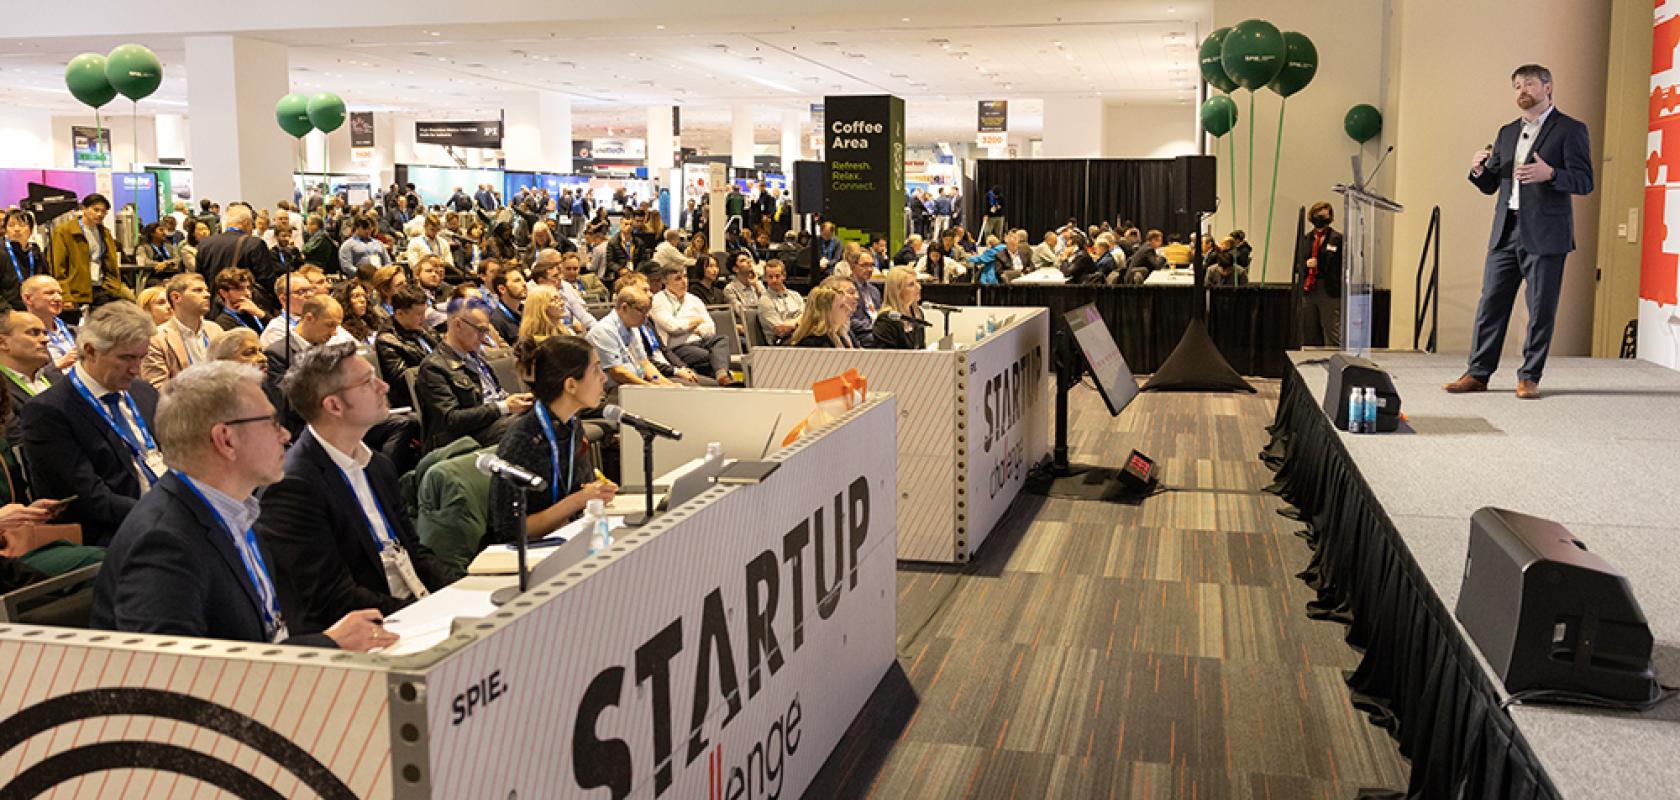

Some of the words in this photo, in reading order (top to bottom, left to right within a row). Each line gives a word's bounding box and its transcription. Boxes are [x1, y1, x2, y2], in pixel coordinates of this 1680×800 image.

[832, 121, 883, 134] Coffee
[832, 136, 869, 149] Area
[831, 161, 872, 170] Refresh.
[831, 171, 862, 180] Relax.
[831, 181, 877, 191] Connect.
[983, 345, 1042, 453] STARTUP
[573, 475, 870, 800] STARTUP
[452, 669, 508, 726] SPIE.
